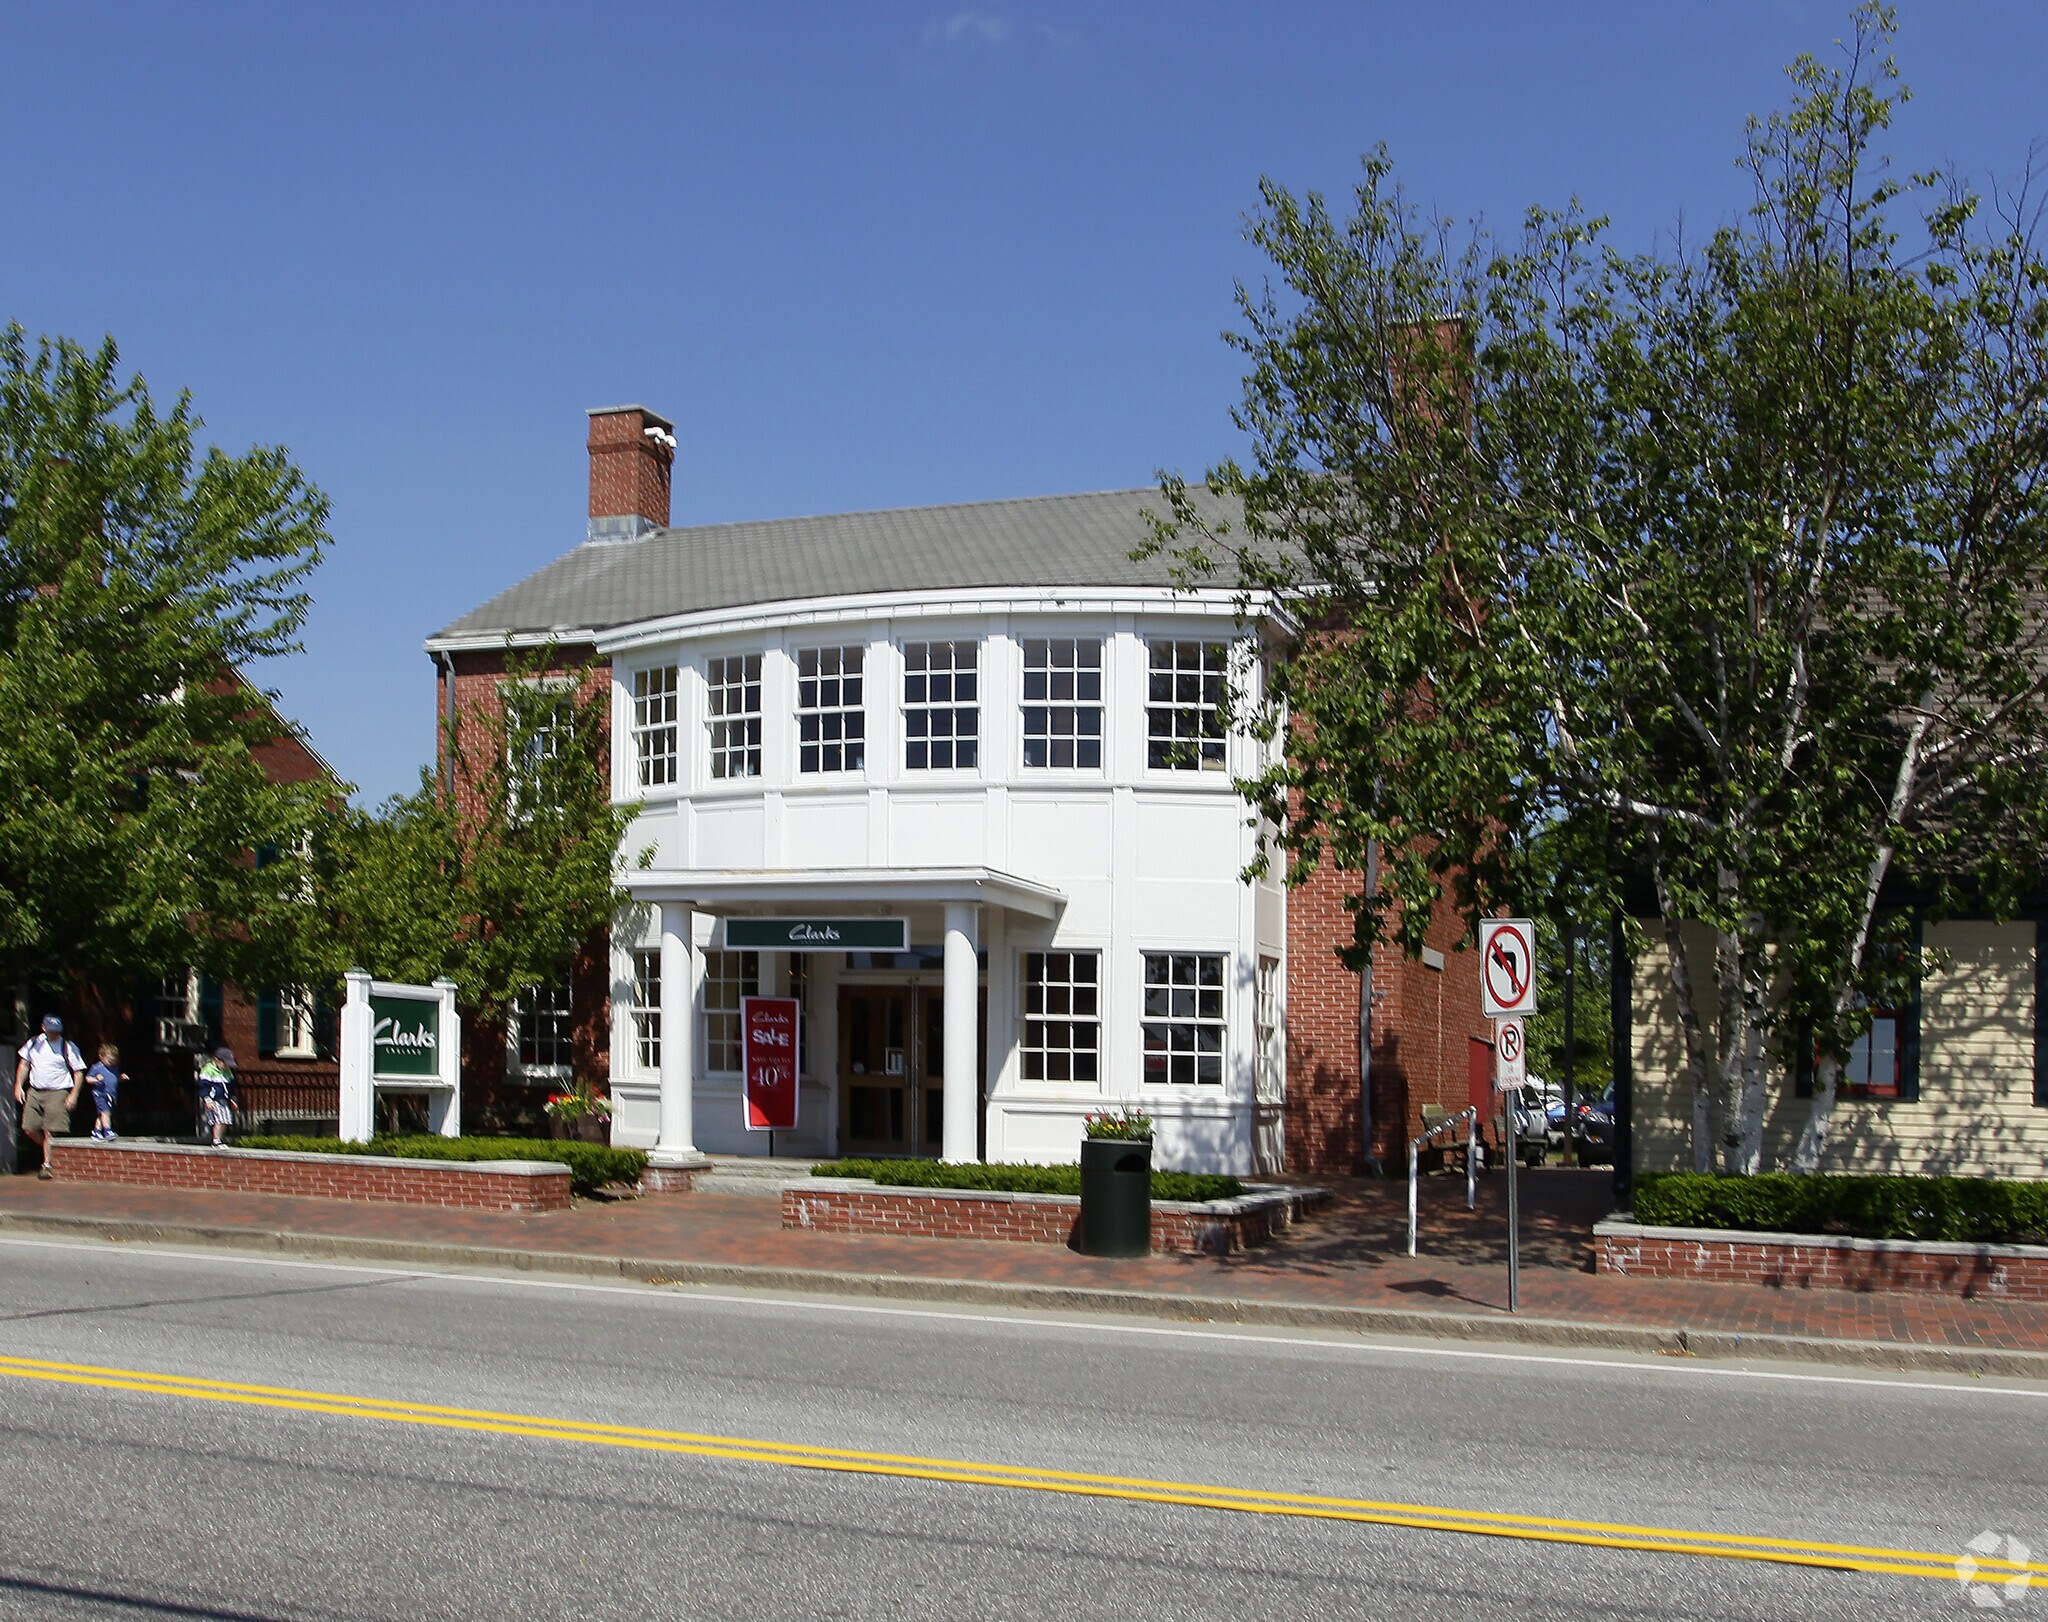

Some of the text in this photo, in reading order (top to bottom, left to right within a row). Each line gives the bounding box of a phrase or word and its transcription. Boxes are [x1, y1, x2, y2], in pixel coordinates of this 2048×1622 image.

[788, 923, 840, 940] Clarks
[752, 1011, 789, 1024] Clarks
[374, 1017, 436, 1048] Clarks
[752, 1028, 790, 1047] SALE
